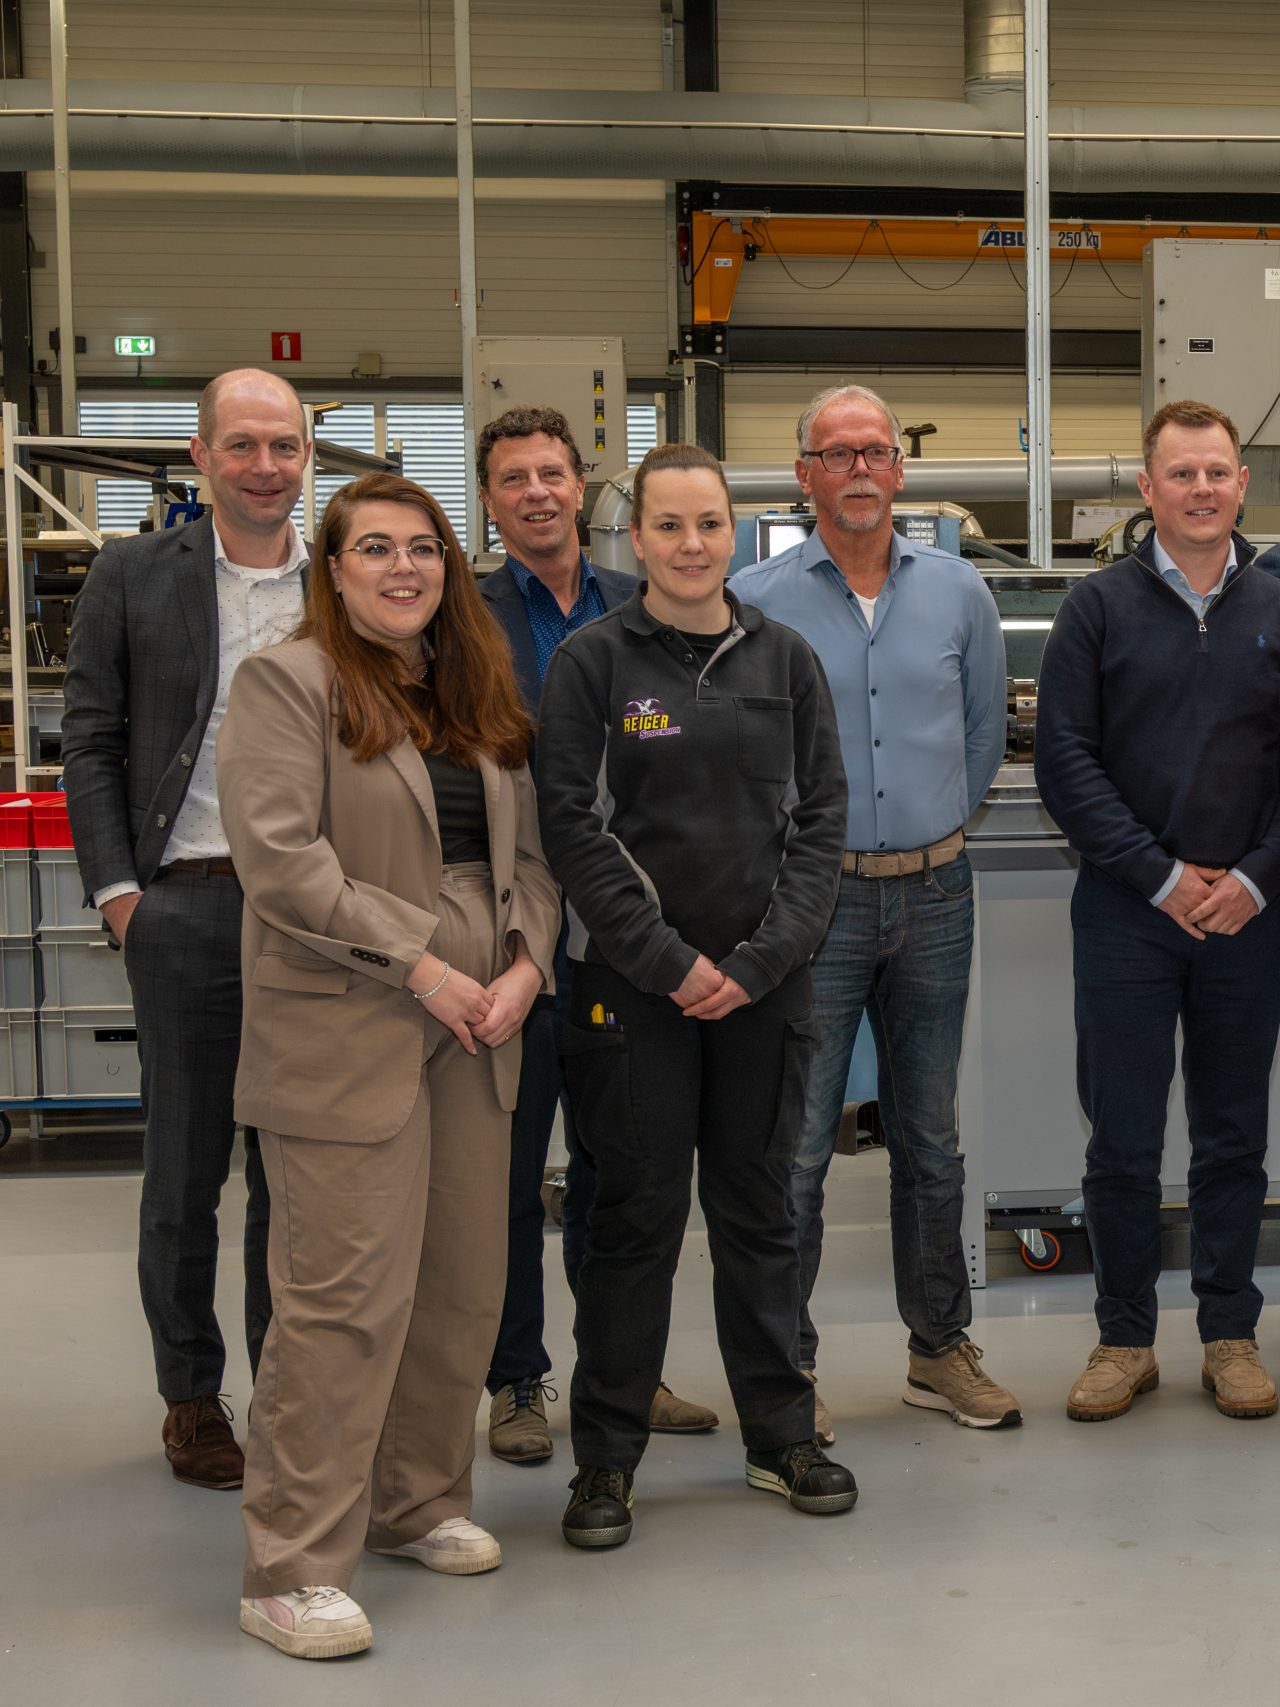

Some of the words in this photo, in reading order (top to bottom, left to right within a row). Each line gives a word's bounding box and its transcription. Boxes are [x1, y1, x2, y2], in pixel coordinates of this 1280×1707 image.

[1058, 232, 1082, 247] 250
[1086, 231, 1100, 249] kg
[623, 714, 669, 733] REIGER
